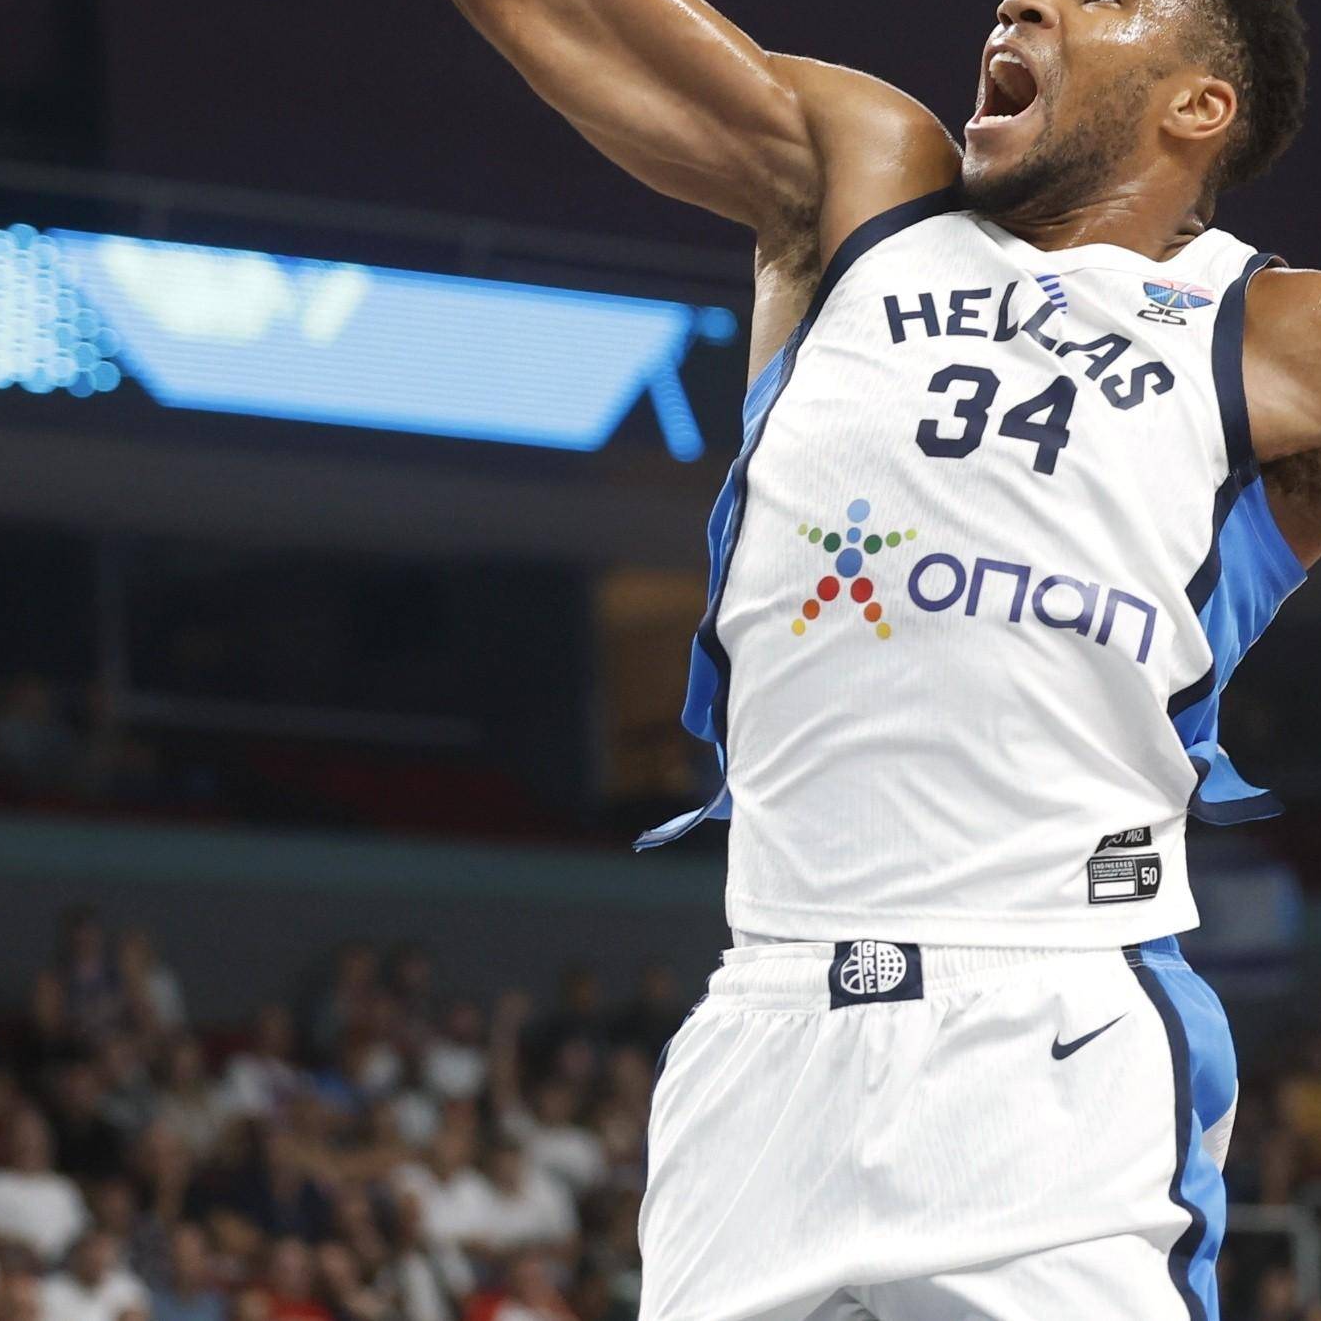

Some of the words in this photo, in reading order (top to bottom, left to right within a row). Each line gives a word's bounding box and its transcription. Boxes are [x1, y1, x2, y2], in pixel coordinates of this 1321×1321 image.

[1137, 303, 1187, 325] 25
[883, 280, 1176, 411] HELLAS
[916, 364, 1078, 475] 34
[1141, 866, 1158, 886] 50
[862, 940, 877, 994] GRE
